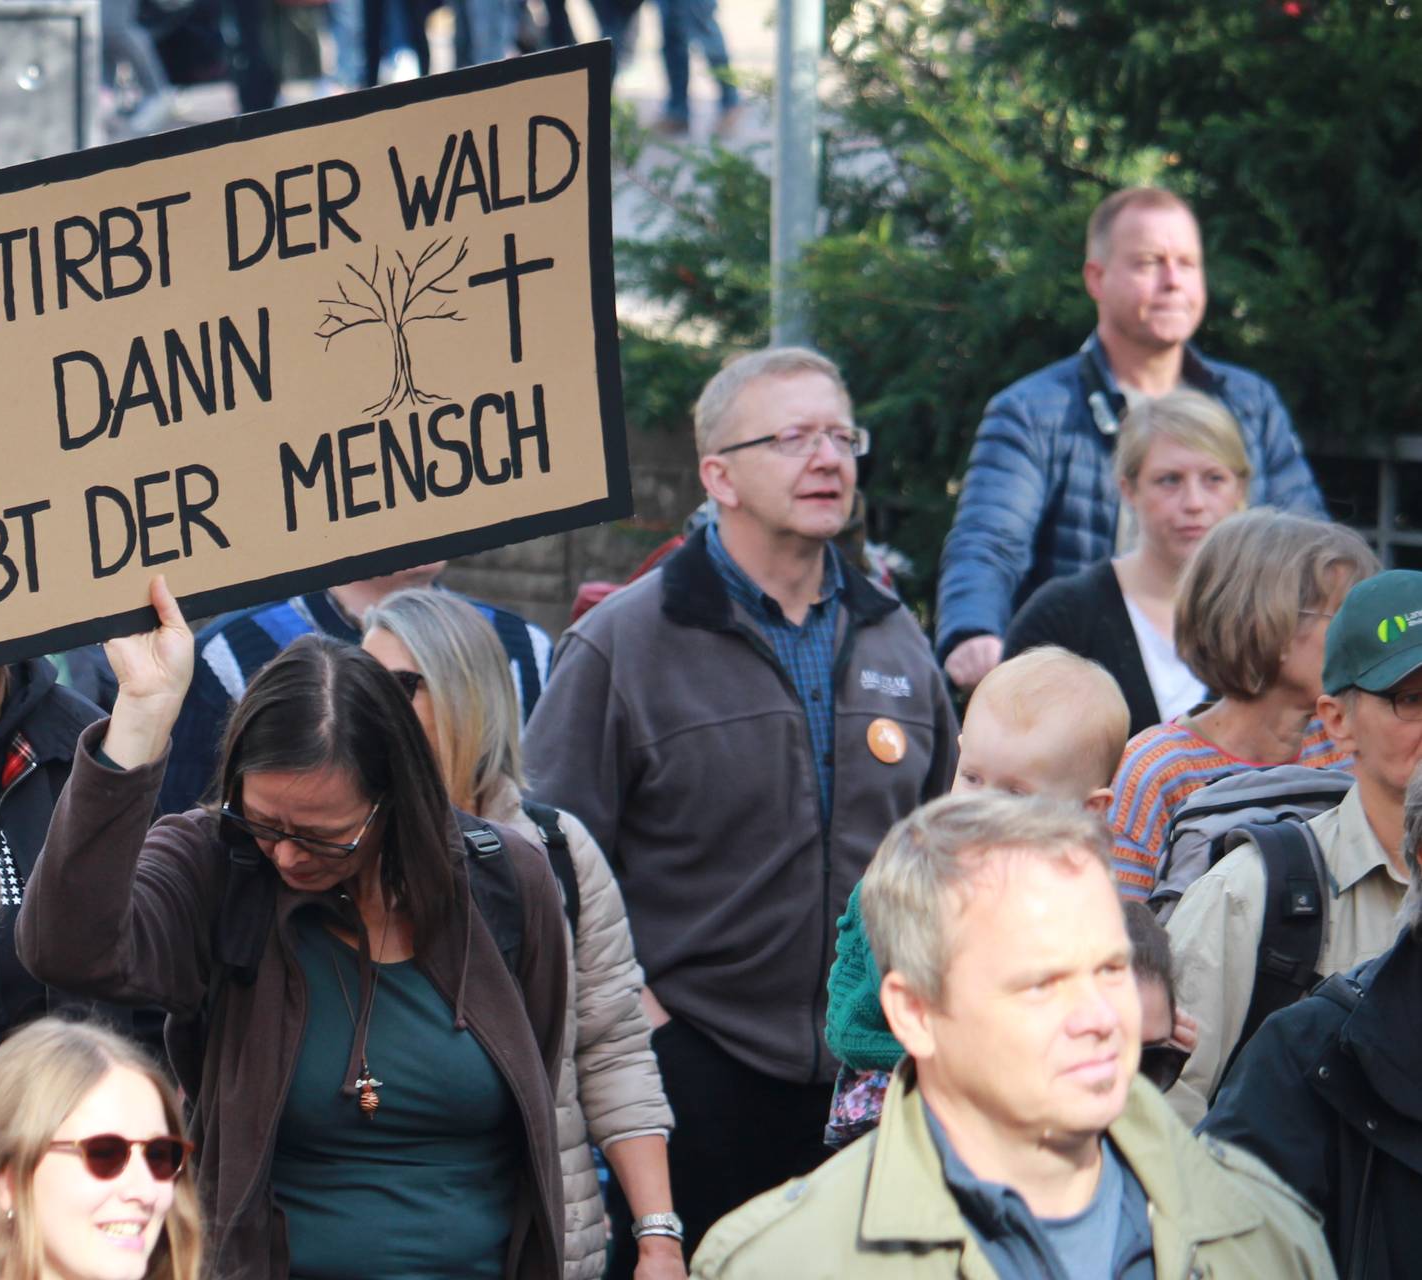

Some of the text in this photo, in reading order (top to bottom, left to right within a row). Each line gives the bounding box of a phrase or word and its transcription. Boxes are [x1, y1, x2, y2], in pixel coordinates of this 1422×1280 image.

[224, 159, 362, 272] DER
[388, 115, 581, 231] WALD
[52, 307, 272, 451] DANN
[84, 463, 231, 579] DER
[279, 383, 551, 532] MENSCH
